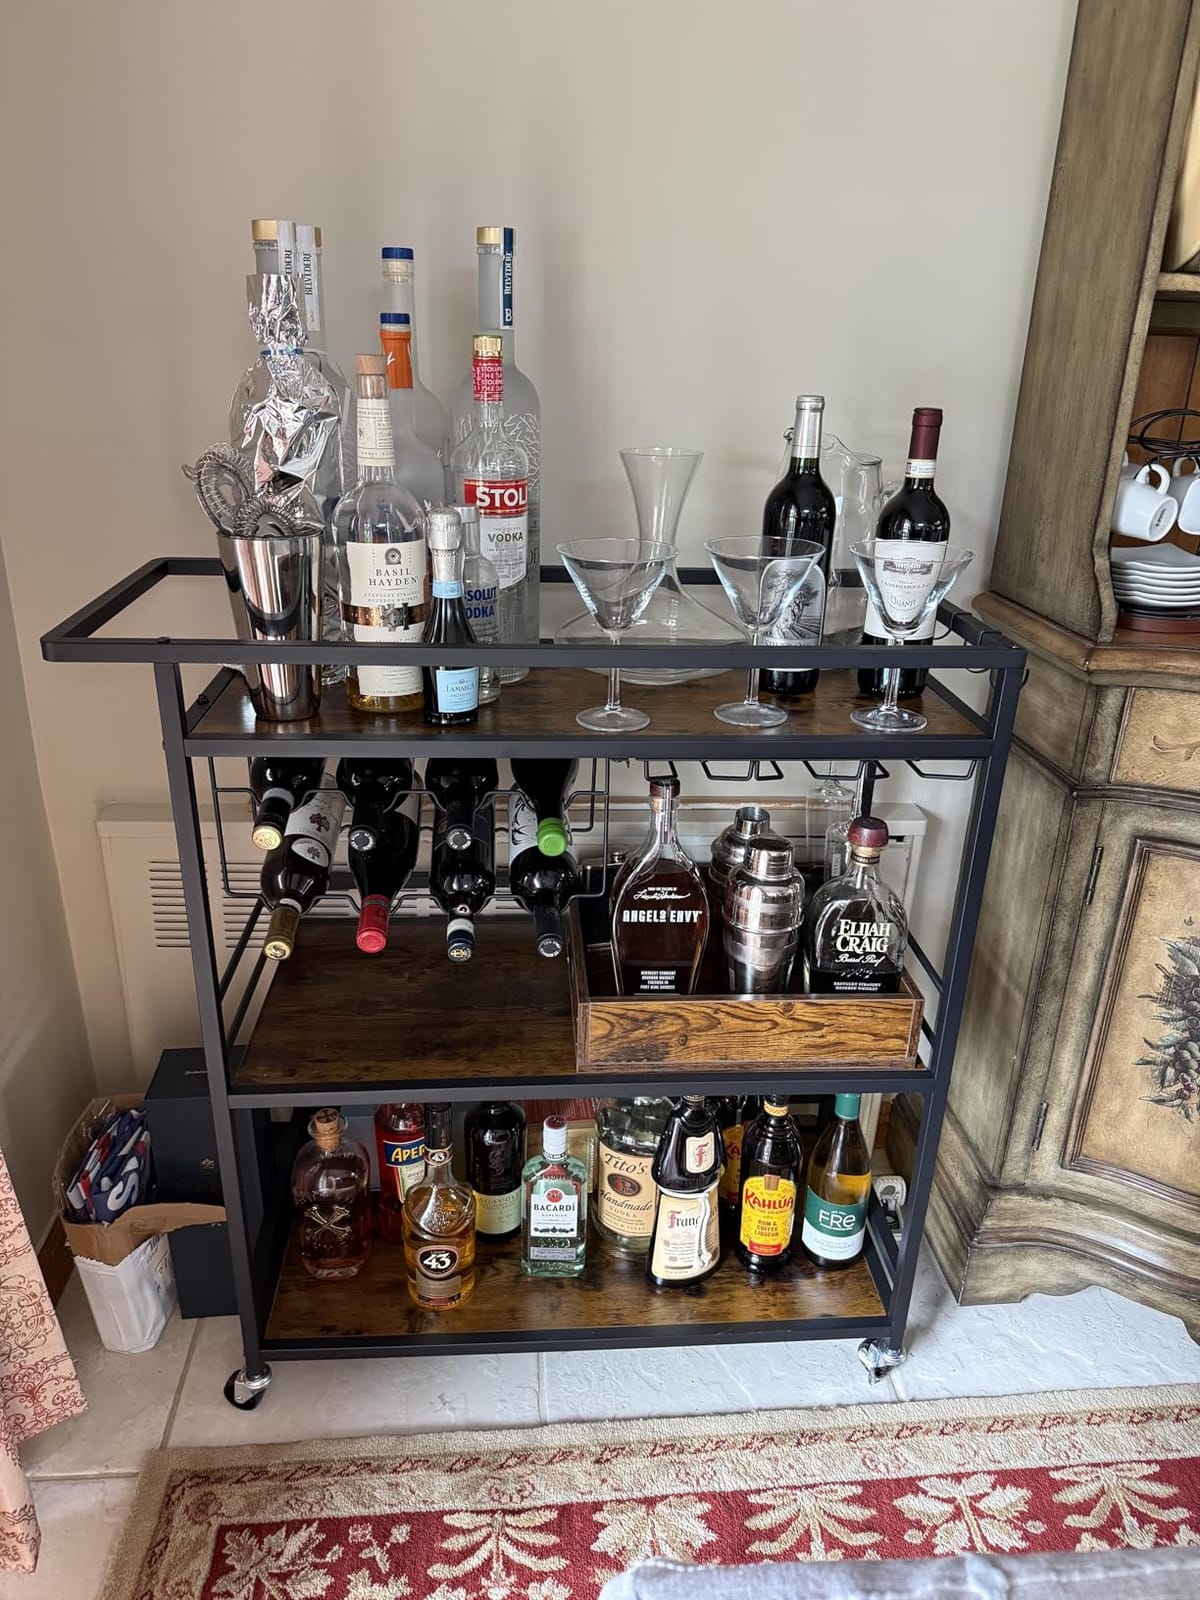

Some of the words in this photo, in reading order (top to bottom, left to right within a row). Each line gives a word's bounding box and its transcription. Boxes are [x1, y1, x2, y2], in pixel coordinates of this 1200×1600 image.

[488, 532, 523, 542] VODKA
[375, 568, 412, 577] BASIL
[465, 587, 497, 601] SOLUT
[466, 605, 494, 620] ODKA
[670, 910, 699, 923] ENVY
[837, 919, 891, 939] ELIJAH
[836, 935, 889, 954] CRAIG
[432, 1153, 445, 1162] 43
[600, 1189, 653, 1211] Handmade
[745, 1188, 794, 1210] KAHLÚA
[423, 1252, 451, 1269] 43
